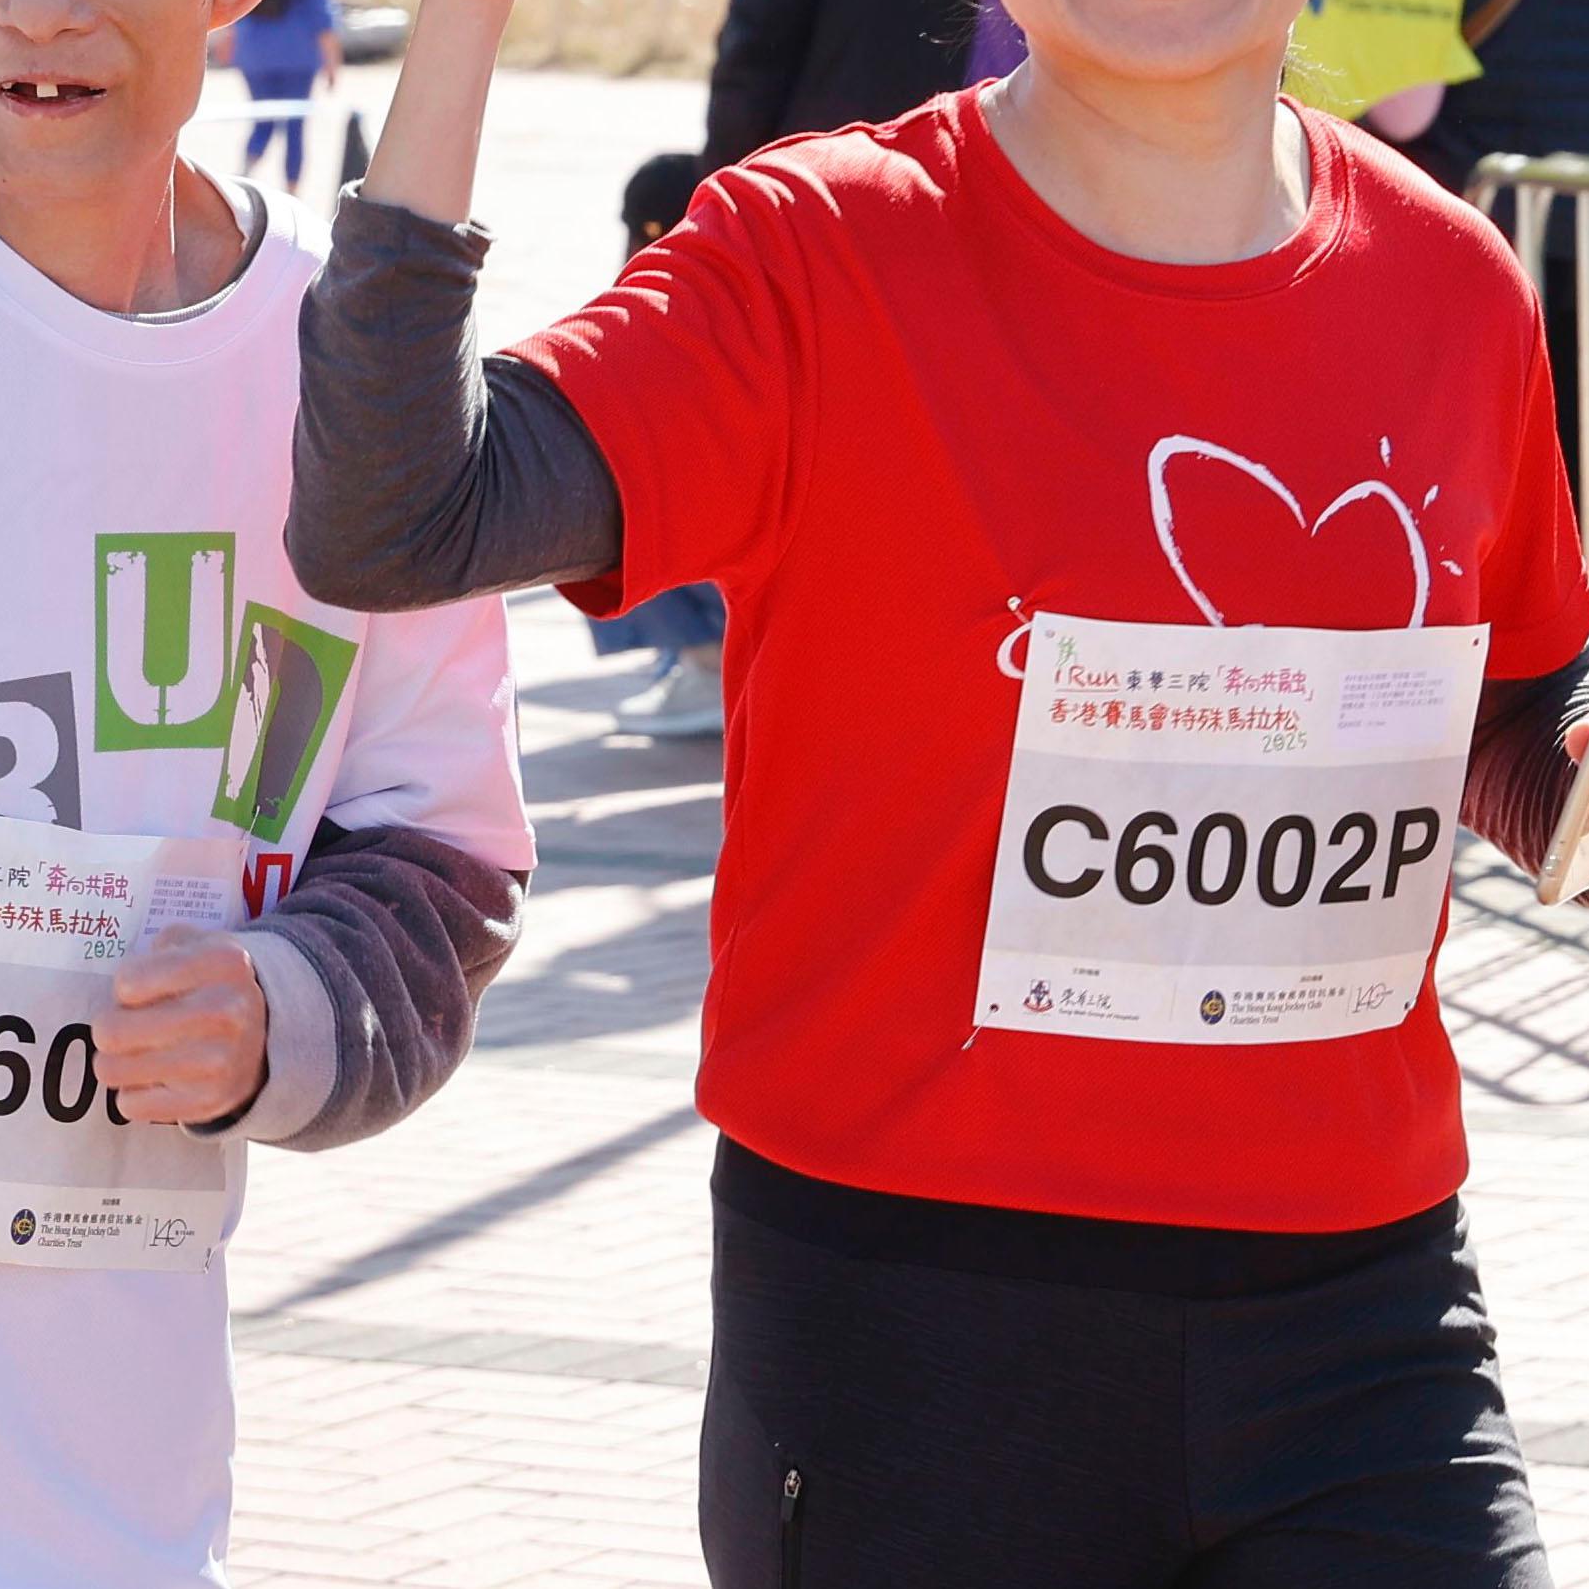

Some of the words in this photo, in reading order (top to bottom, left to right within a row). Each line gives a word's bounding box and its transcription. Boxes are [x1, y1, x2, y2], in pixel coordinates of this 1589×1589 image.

[1048, 697, 1301, 732] 香港賽馬會特殊馬拉松
[1262, 732, 1308, 754] 2025
[1023, 804, 1441, 908] C6002P
[84, 940, 127, 960] 2025
[1231, 1004, 1245, 1013] The
[1246, 1003, 1265, 1014] Hong
[1266, 1002, 1284, 1013] Kong
[1285, 1002, 1306, 1013] Jockey
[1307, 1001, 1323, 1010] Club
[1229, 1015, 1260, 1025] Charities
[1261, 1015, 1280, 1024] Trust
[41, 1224, 54, 1235] The
[54, 1225, 71, 1237] Hong
[72, 1226, 87, 1237] Kong
[87, 1226, 106, 1238] Jockey
[106, 1227, 121, 1237] Club
[149, 1218, 188, 1248] 140
[37, 1236, 66, 1248] Charities
[66, 1238, 83, 1249] Trust
